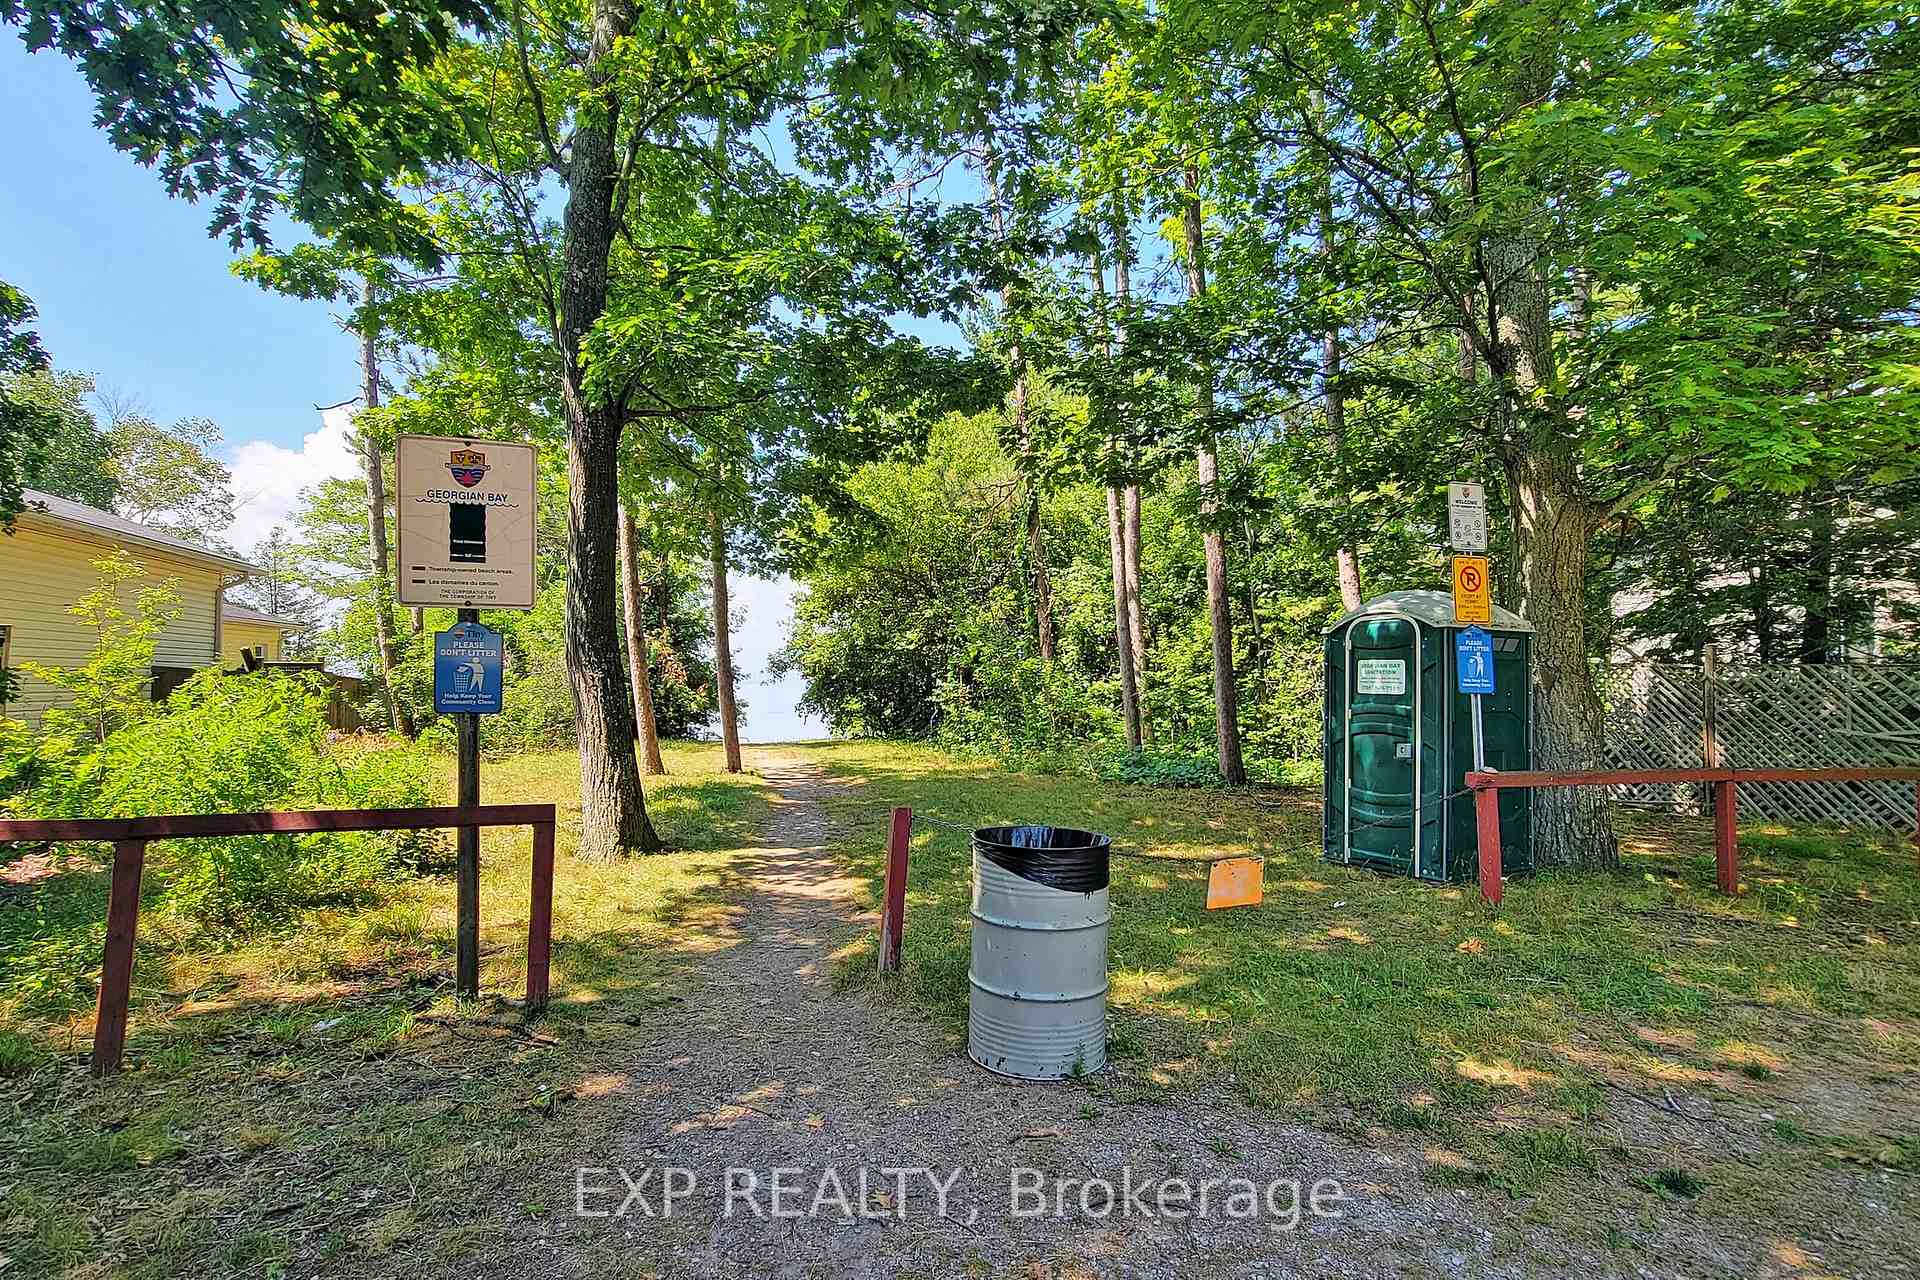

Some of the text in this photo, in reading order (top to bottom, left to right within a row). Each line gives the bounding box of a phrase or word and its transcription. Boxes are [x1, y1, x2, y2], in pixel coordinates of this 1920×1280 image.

[427, 489, 508, 502] GEORGIAN BAY
[453, 641, 485, 649] PLEASE
